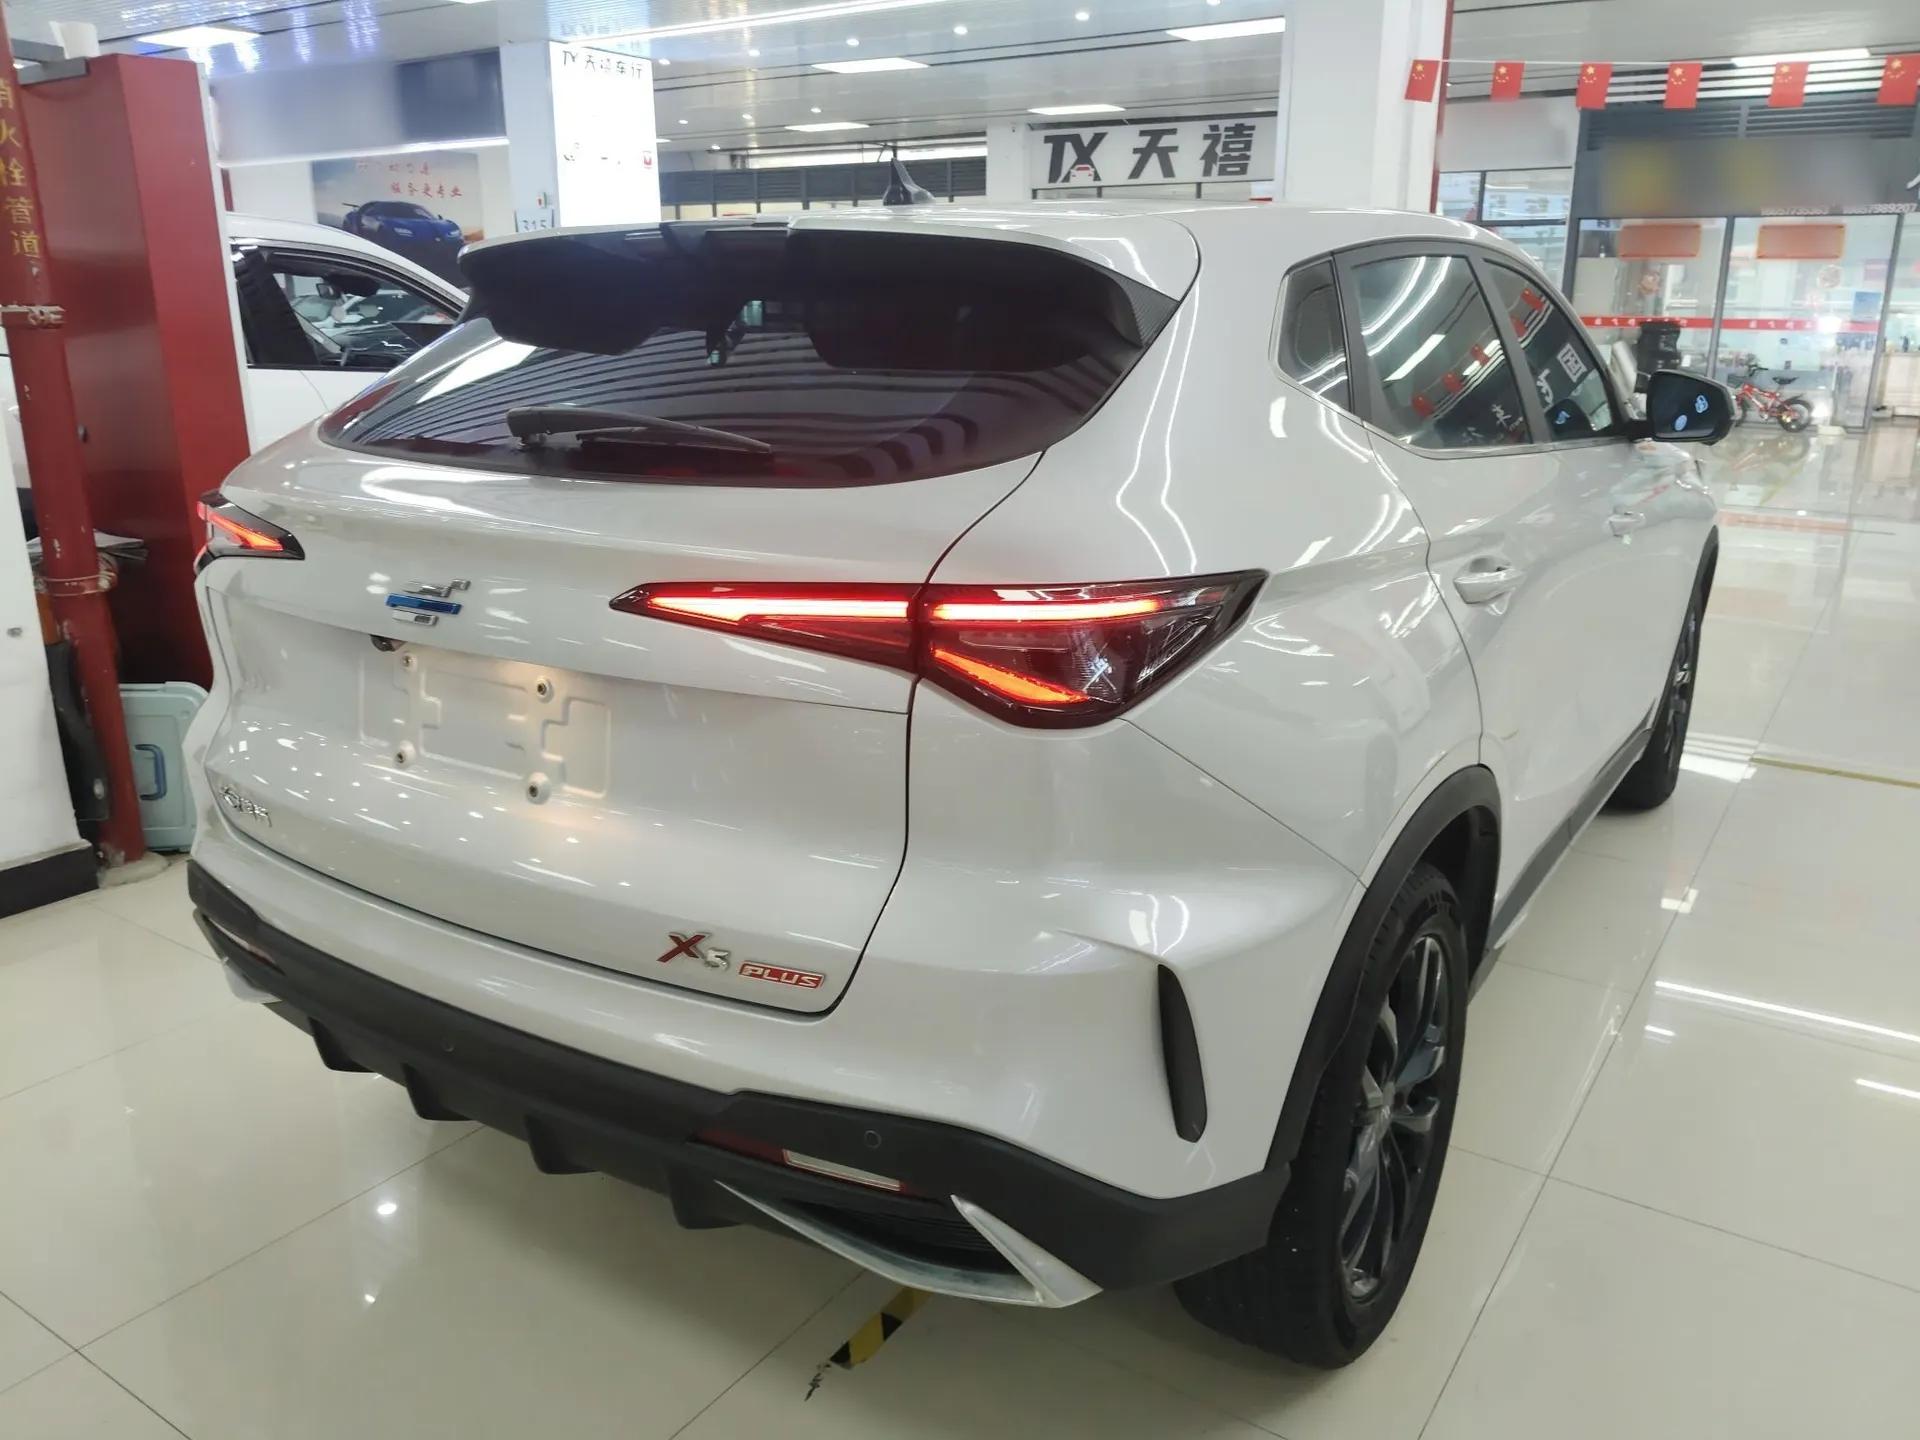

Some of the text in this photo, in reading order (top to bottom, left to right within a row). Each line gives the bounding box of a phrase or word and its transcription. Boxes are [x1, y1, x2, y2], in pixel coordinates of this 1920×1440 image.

[1044, 123, 1256, 184] TX 天禧
[742, 965, 819, 987] PLUS
